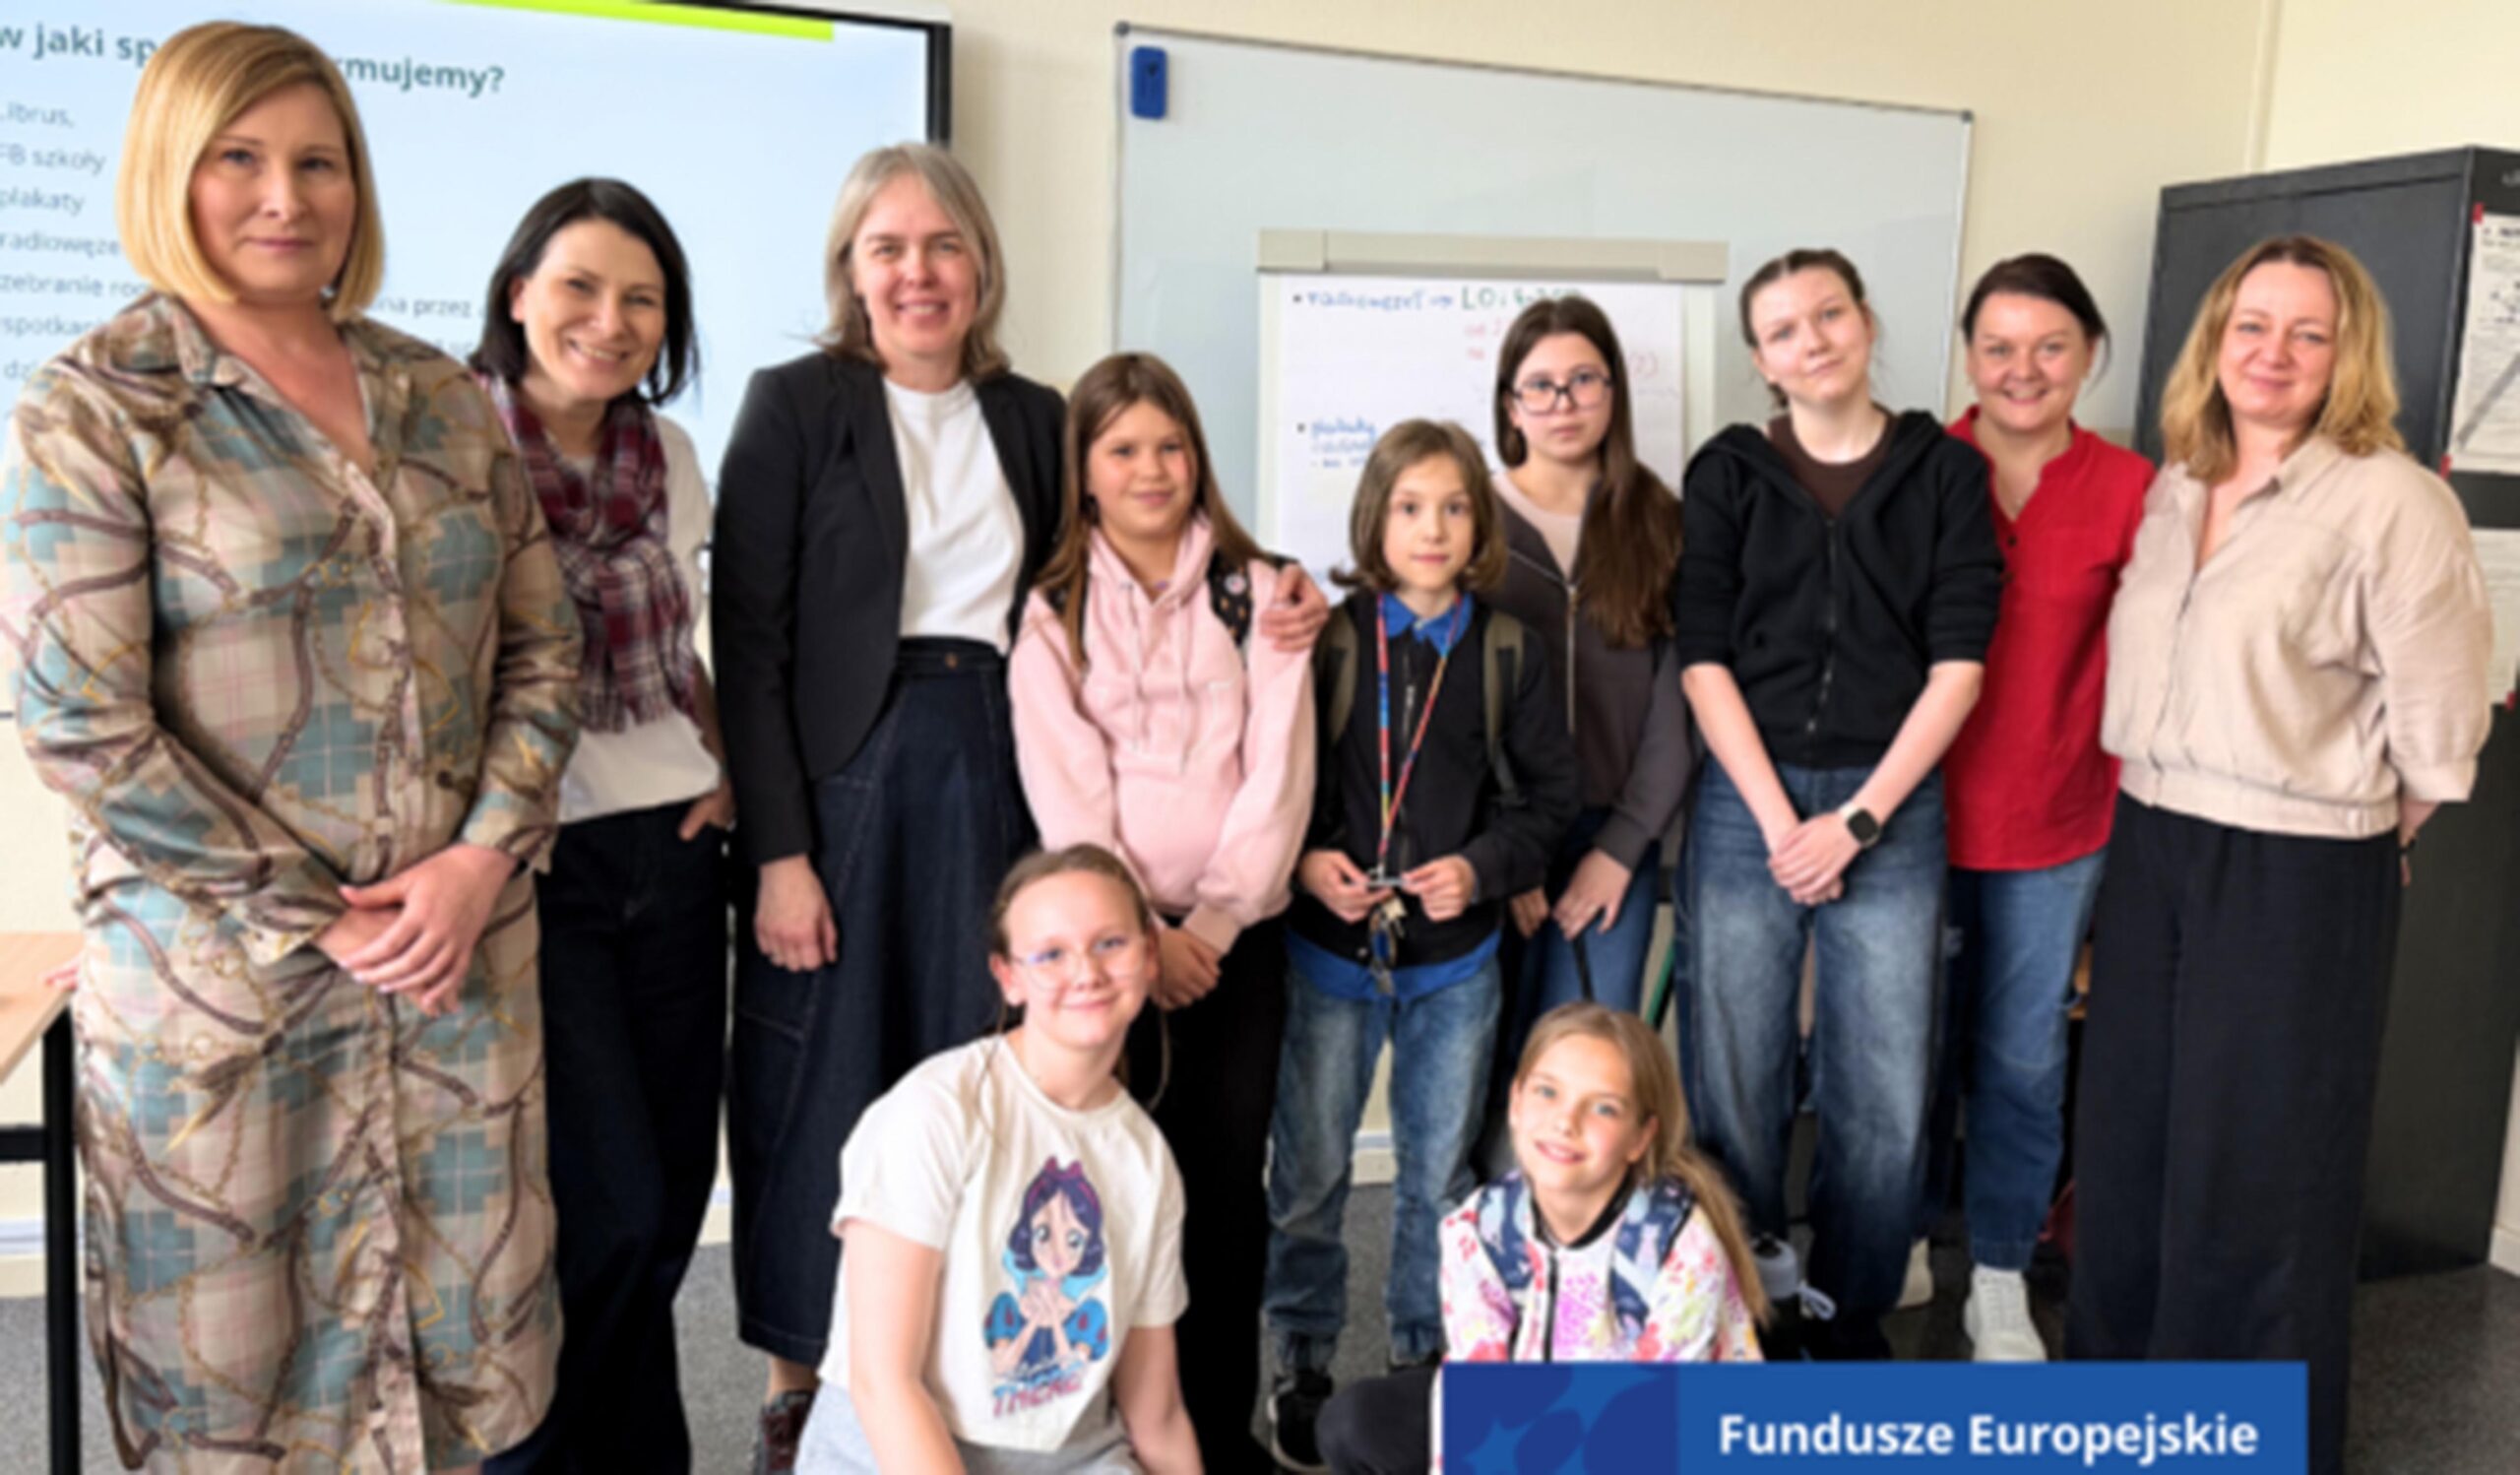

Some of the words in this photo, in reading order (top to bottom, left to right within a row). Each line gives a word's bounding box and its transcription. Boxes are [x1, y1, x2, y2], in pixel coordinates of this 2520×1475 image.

[32, 22, 103, 60] jaki
[336, 55, 505, 99] mujemy?
[0, 100, 75, 128] ibrus,
[32, 150, 106, 176] szkoły
[413, 298, 472, 319] przez
